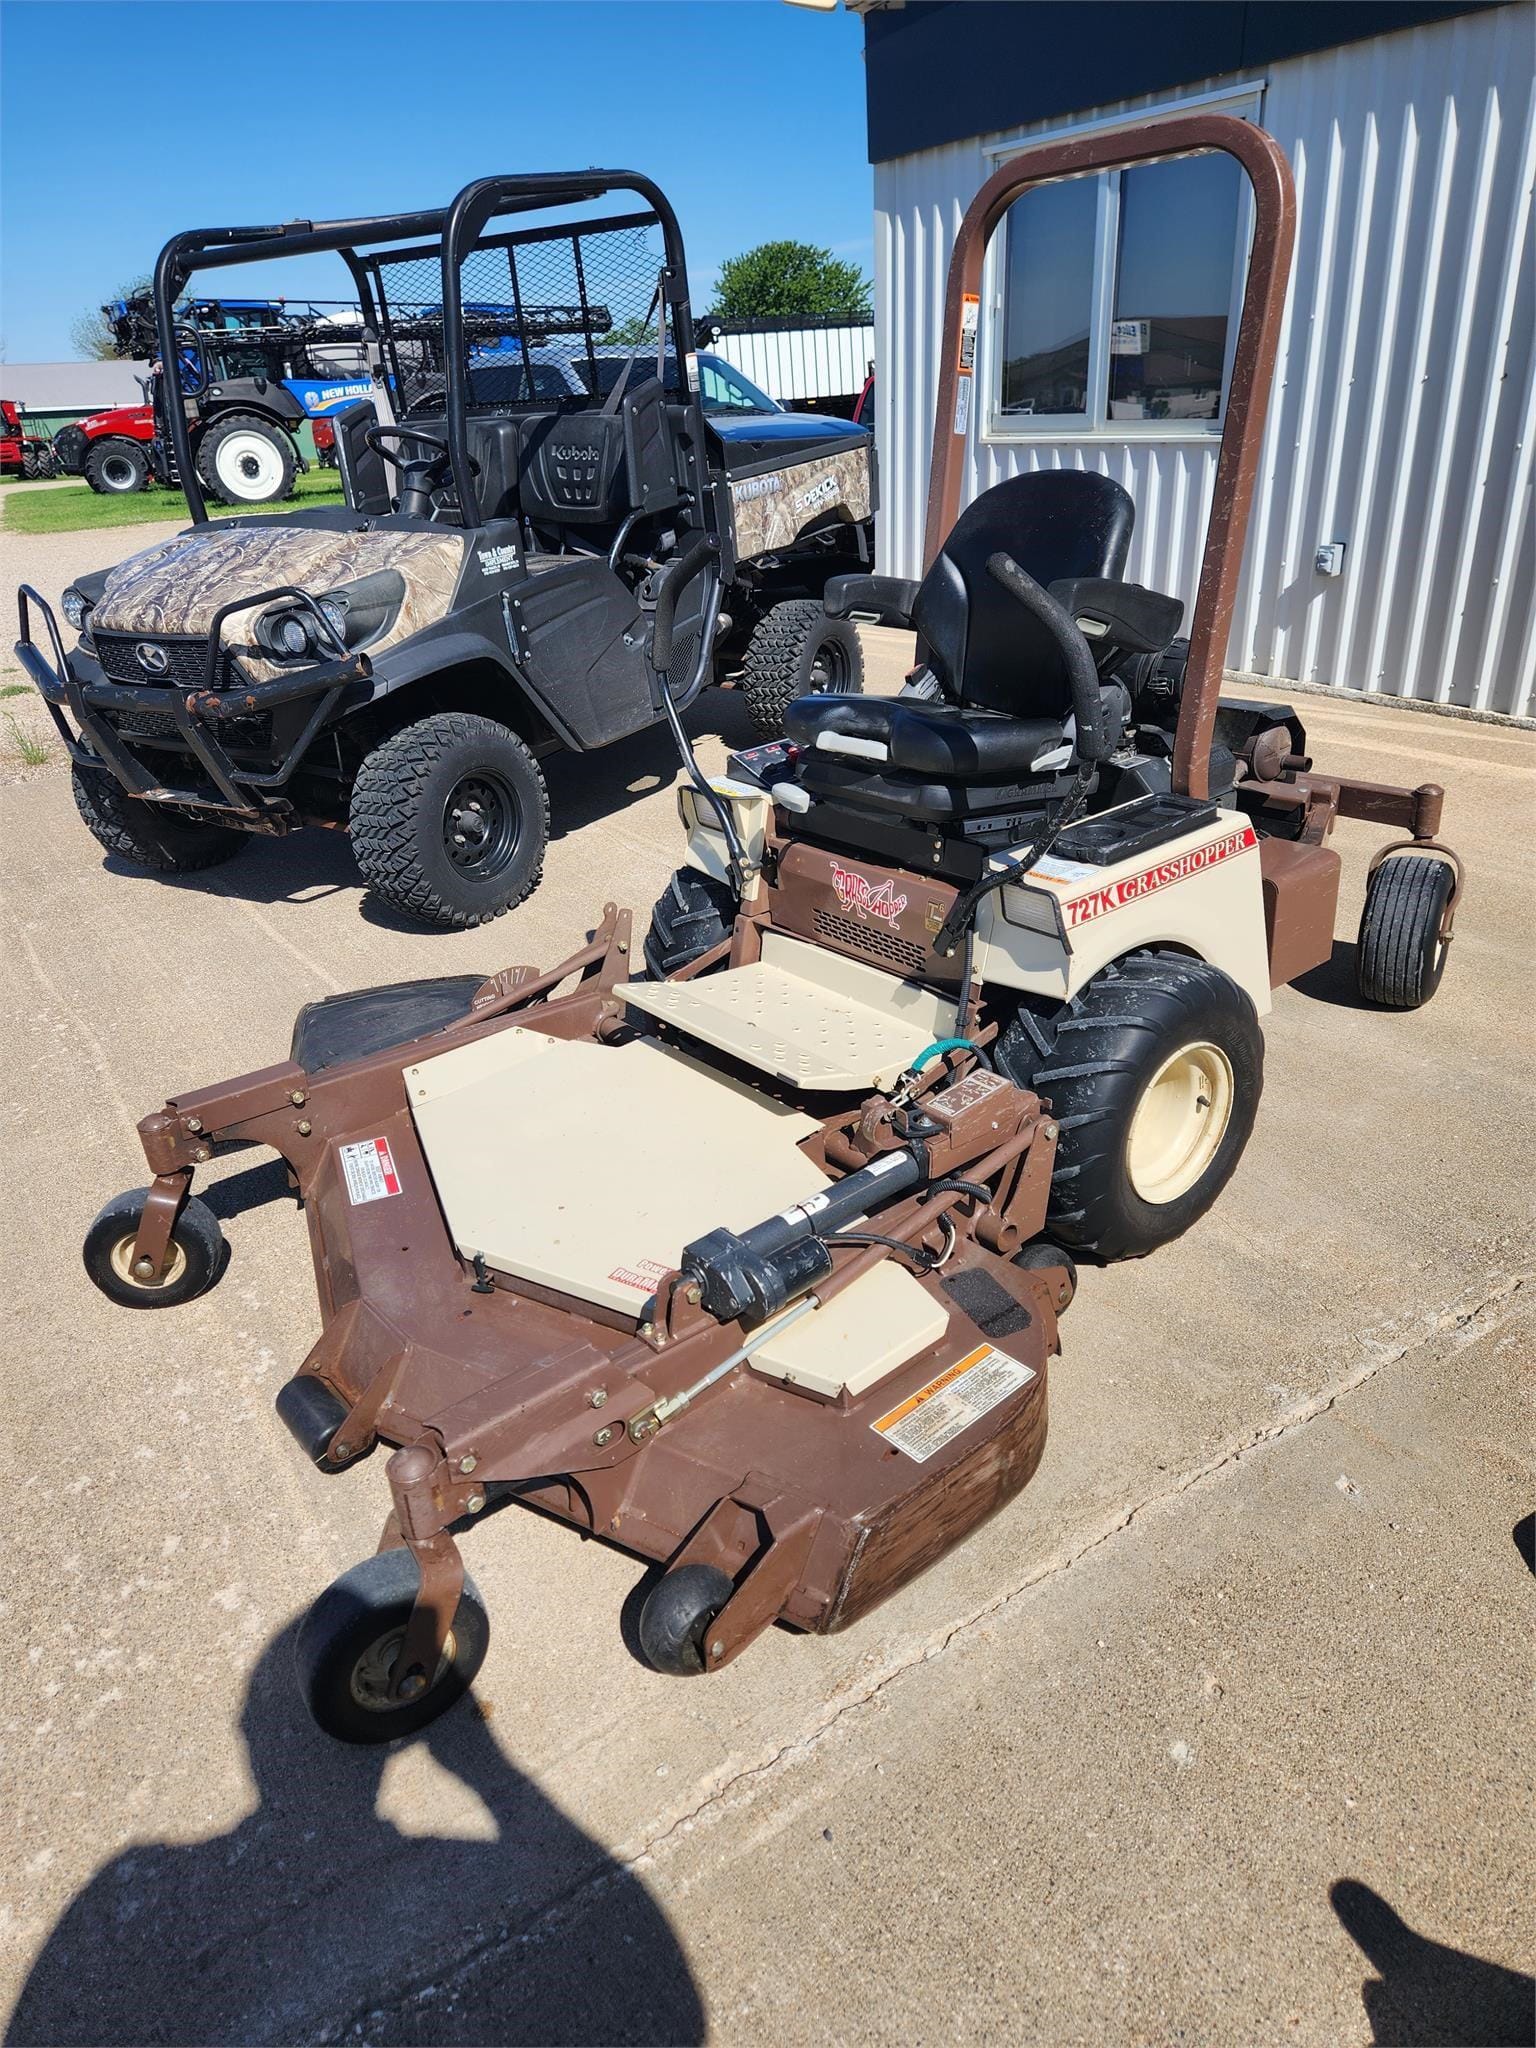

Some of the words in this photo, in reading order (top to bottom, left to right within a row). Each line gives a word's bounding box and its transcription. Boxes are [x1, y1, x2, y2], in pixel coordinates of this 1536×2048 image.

[321, 387, 345, 400] NEW
[345, 383, 374, 396] HOLLA
[551, 444, 600, 461] Kubota
[734, 475, 782, 502] KUBOTA
[1067, 886, 1117, 926] 727K
[1122, 831, 1246, 900] GRASSHOPPER
[924, 1368, 963, 1397] WARNING
